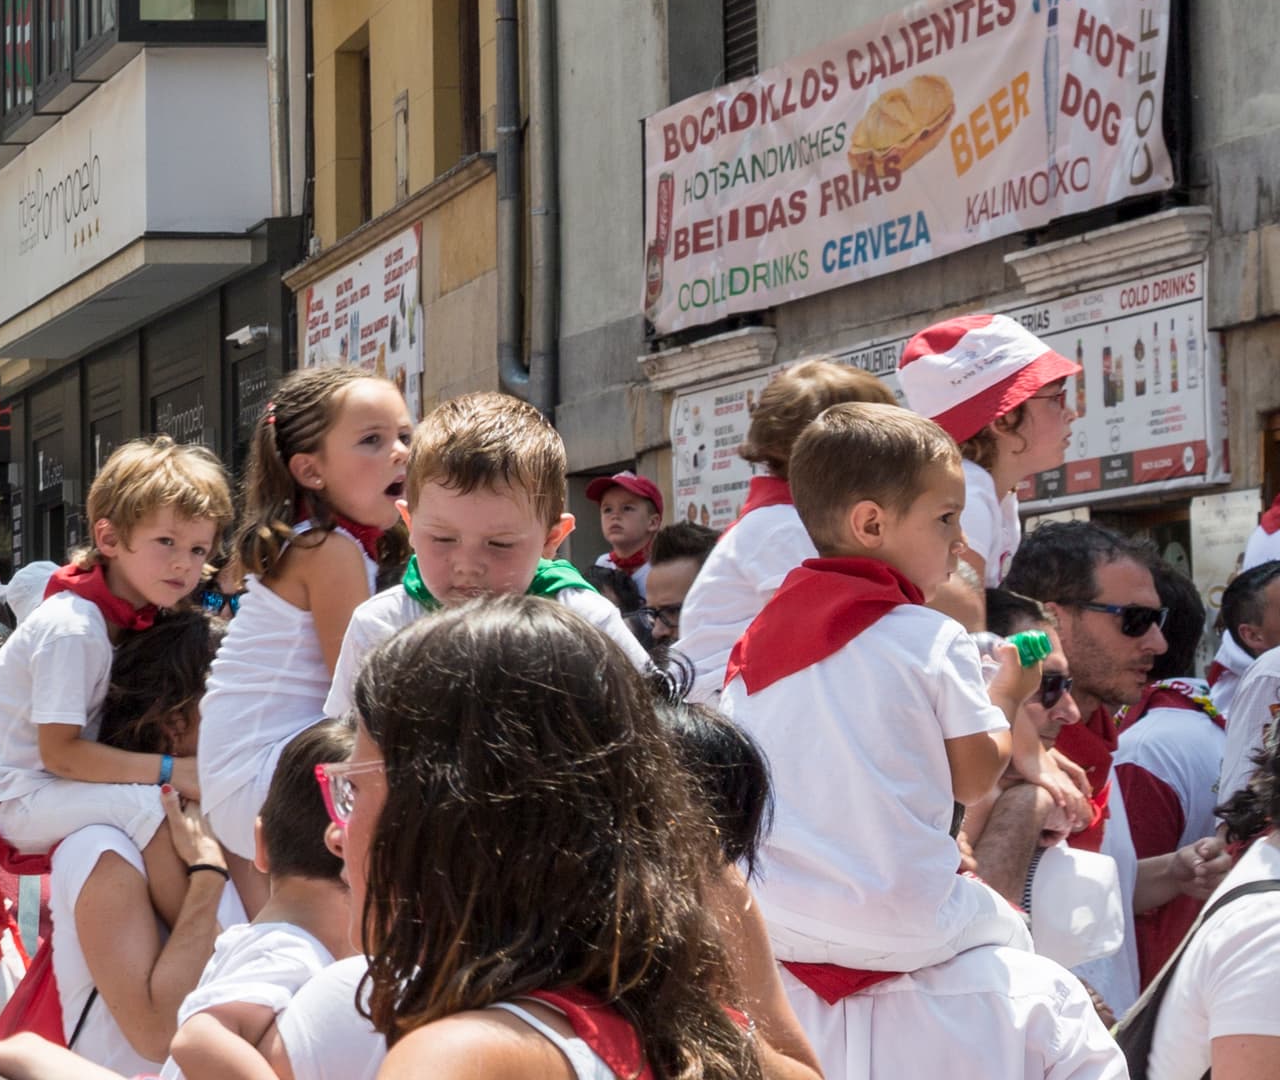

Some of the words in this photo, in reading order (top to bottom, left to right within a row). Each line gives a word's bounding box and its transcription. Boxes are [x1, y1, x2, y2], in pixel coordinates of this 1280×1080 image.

[1073, 7, 1136, 79] HOT
[949, 70, 1032, 179] BEER
[1059, 72, 1123, 147] DOG
[821, 210, 932, 274] CERVEZA
[1120, 283, 1150, 310] COLD
[1152, 272, 1197, 304] DRINKS
